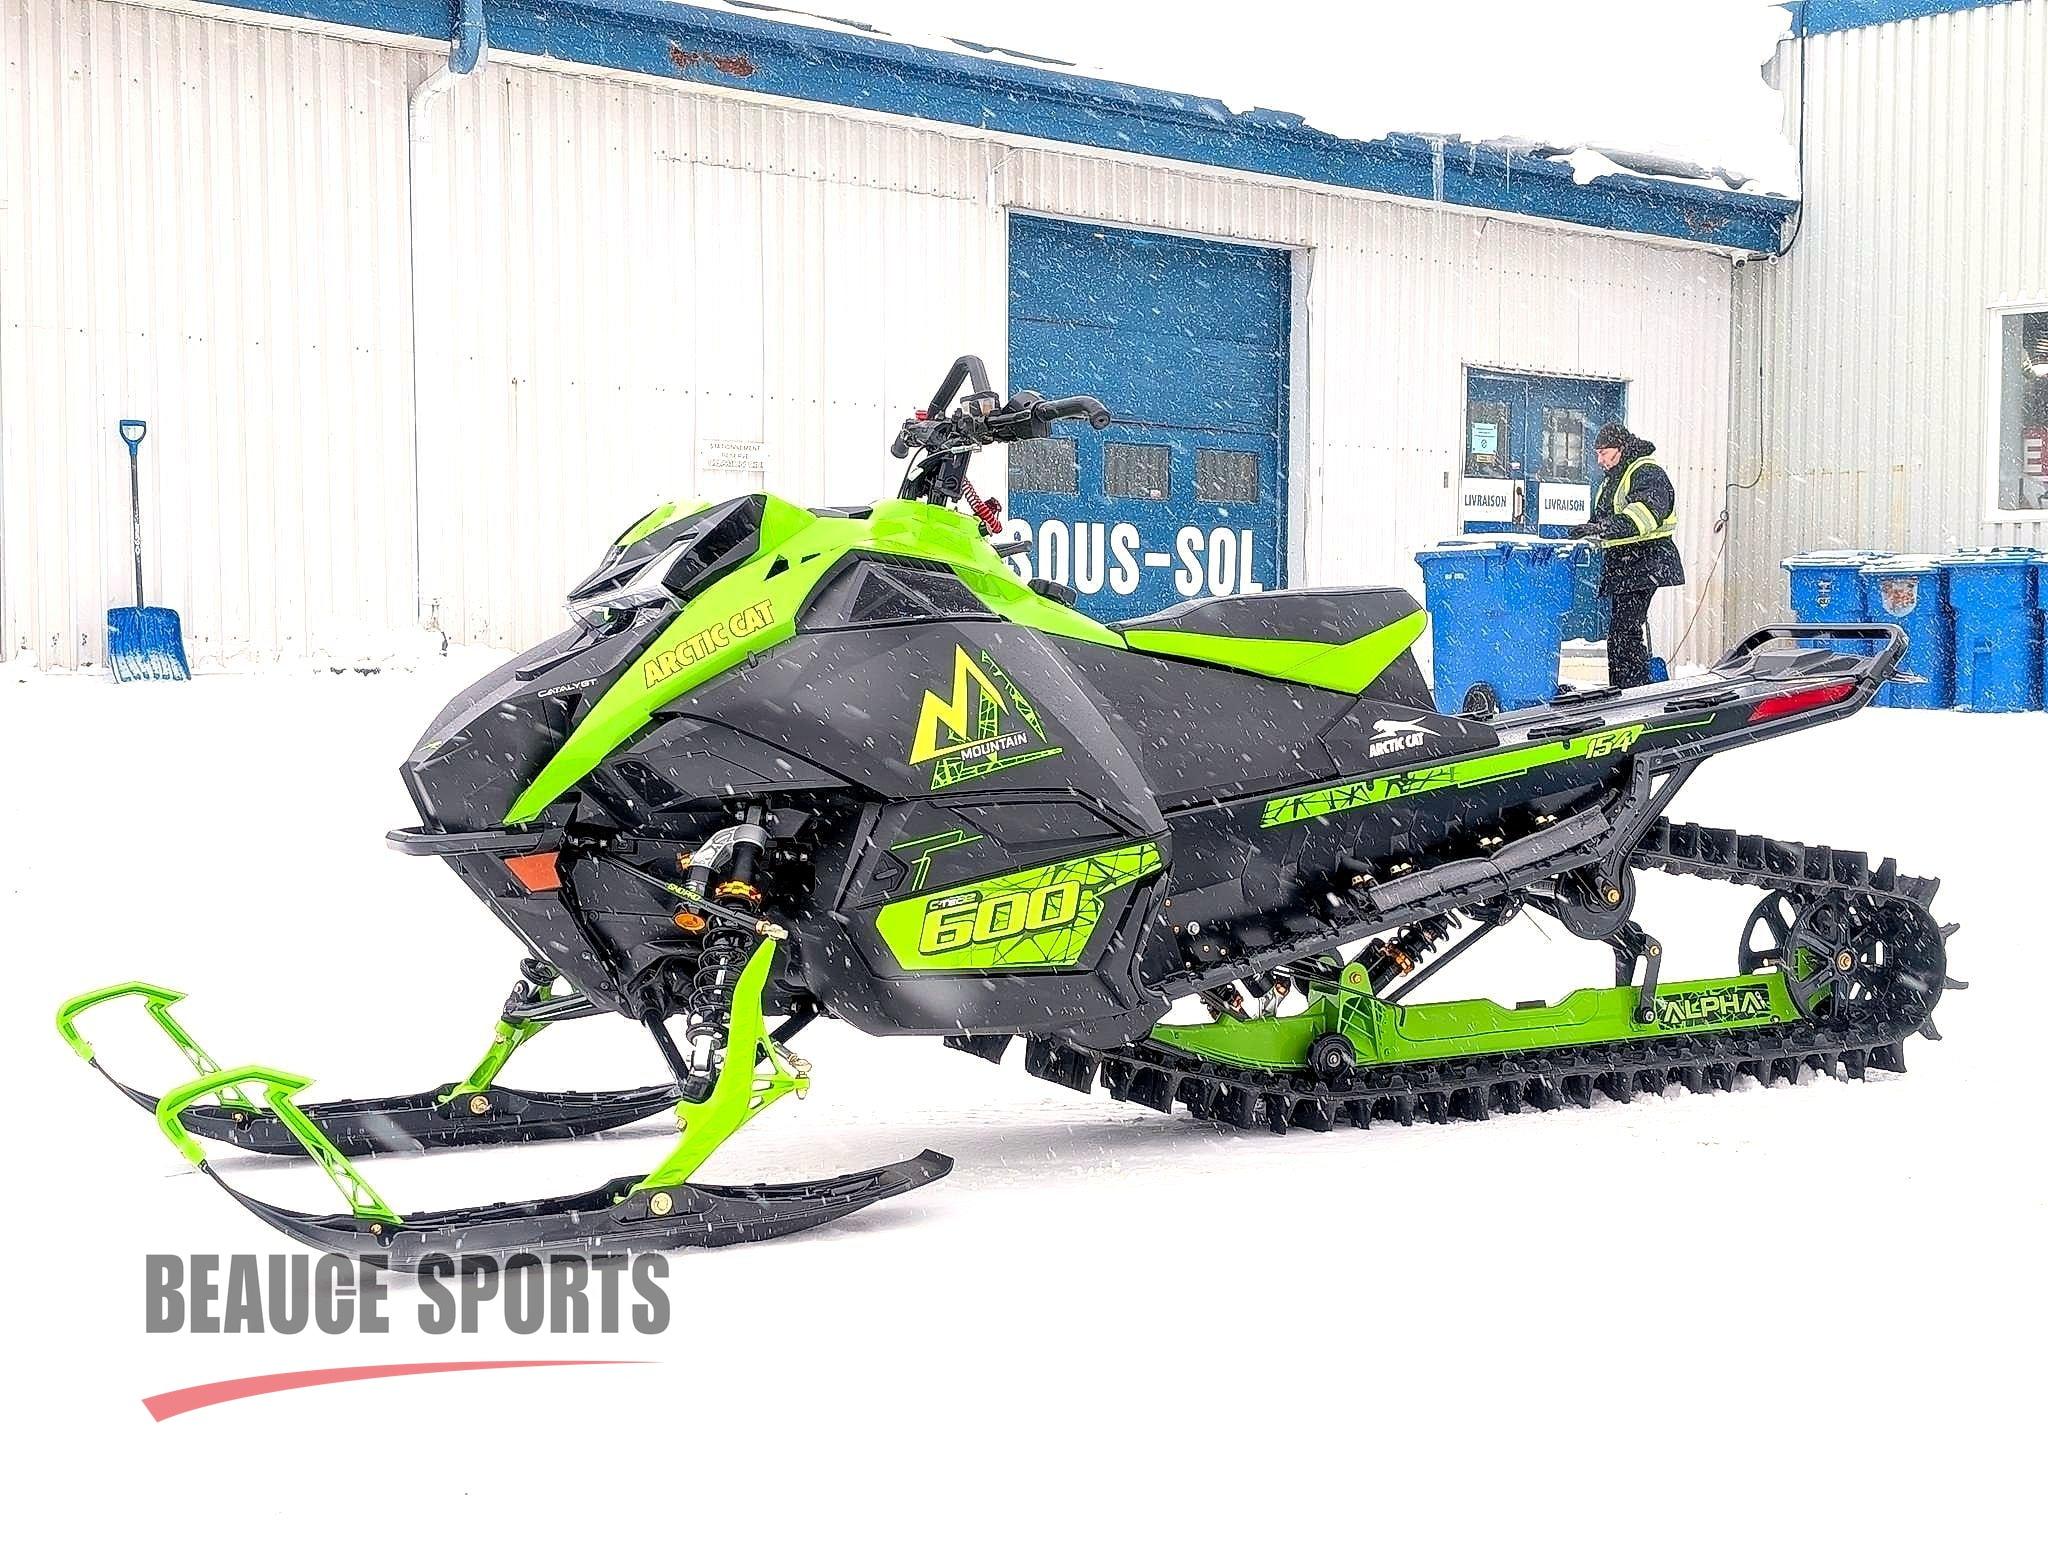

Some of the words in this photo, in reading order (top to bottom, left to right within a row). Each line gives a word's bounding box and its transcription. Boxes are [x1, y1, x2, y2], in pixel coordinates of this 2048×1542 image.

[1464, 494, 1507, 507] LIVRAISON
[1544, 498, 1585, 512] LIVRAISON
[1004, 519, 1263, 597] SOUS-SOL
[643, 622, 729, 689] ARCTIC
[728, 599, 774, 638] CAT
[960, 731, 1028, 761] MOUNTAIN
[1369, 736, 1405, 758] ARCTIC
[1405, 732, 1424, 748] CAT
[1585, 730, 1633, 760] 154
[918, 879, 1081, 956] 600
[1662, 991, 1763, 1024] ALPHA
